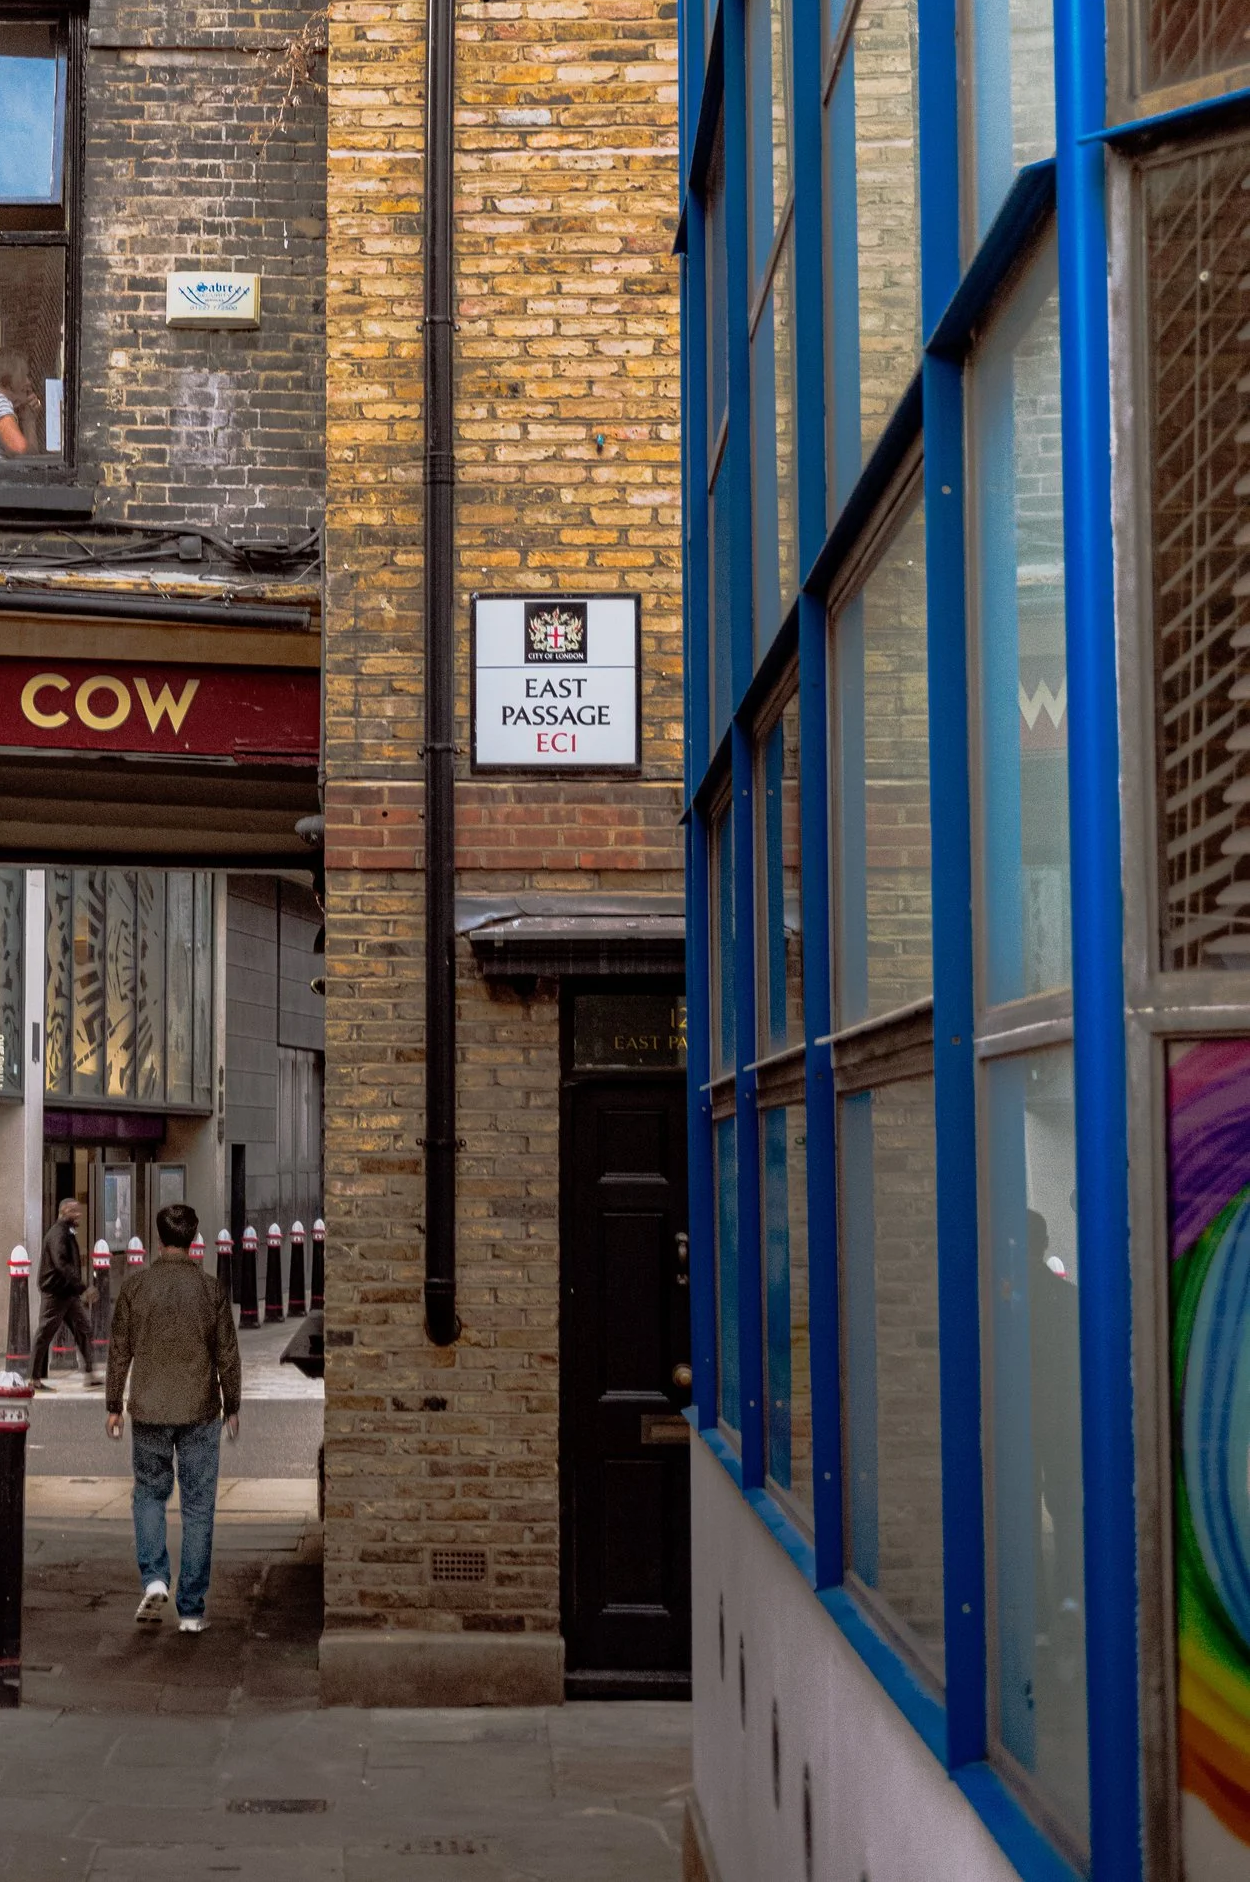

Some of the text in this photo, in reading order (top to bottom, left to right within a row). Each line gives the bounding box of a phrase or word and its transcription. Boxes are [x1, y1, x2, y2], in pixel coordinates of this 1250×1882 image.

[525, 678, 587, 698] EAST
[20, 672, 201, 736] COW
[502, 705, 611, 726] PASSAGE
[536, 732, 576, 753] EC1
[614, 1035, 657, 1050] EAST
